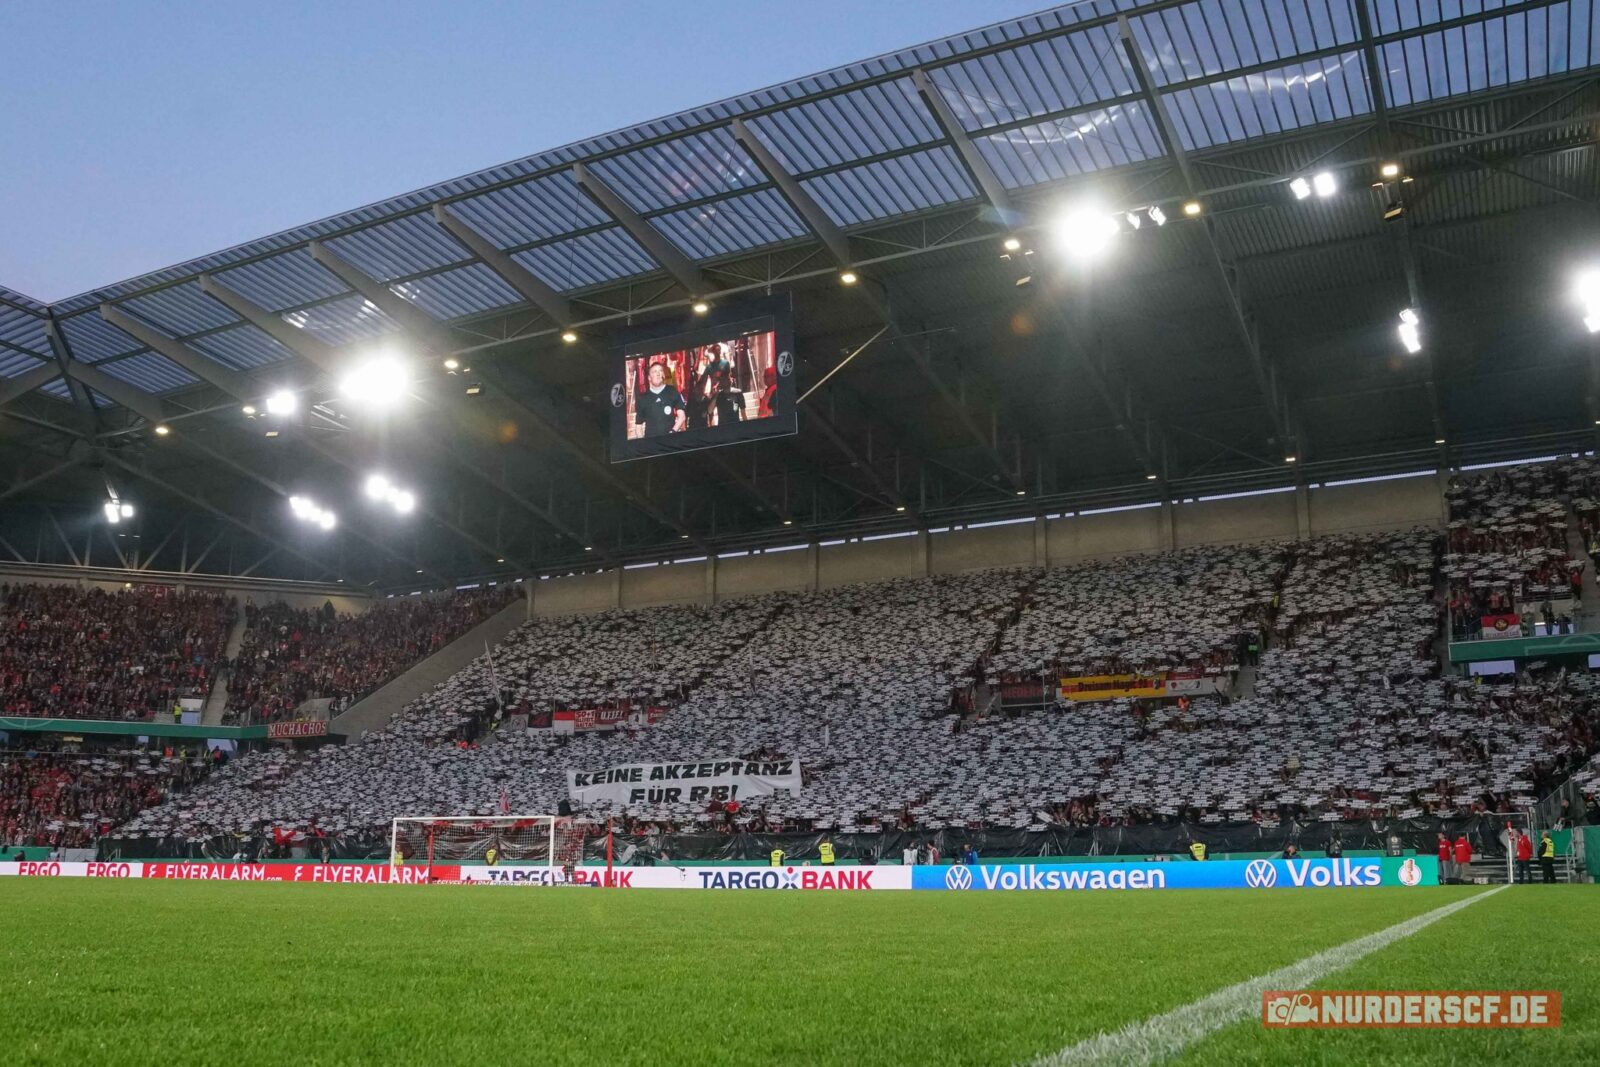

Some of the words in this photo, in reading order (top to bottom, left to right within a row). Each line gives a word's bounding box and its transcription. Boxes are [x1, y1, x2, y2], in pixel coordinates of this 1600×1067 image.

[269, 722, 326, 736] MUCHACHOS
[575, 767, 643, 787] KEINE
[649, 760, 793, 781] AKZEPTANZ
[629, 785, 682, 804] FÜR
[689, 784, 738, 802] RB!
[18, 862, 61, 877] ERGO
[86, 863, 131, 878] ERGO
[312, 866, 430, 885] FLYERALARM
[980, 864, 1166, 889] Volkswagen
[1285, 857, 1382, 887] Volks
